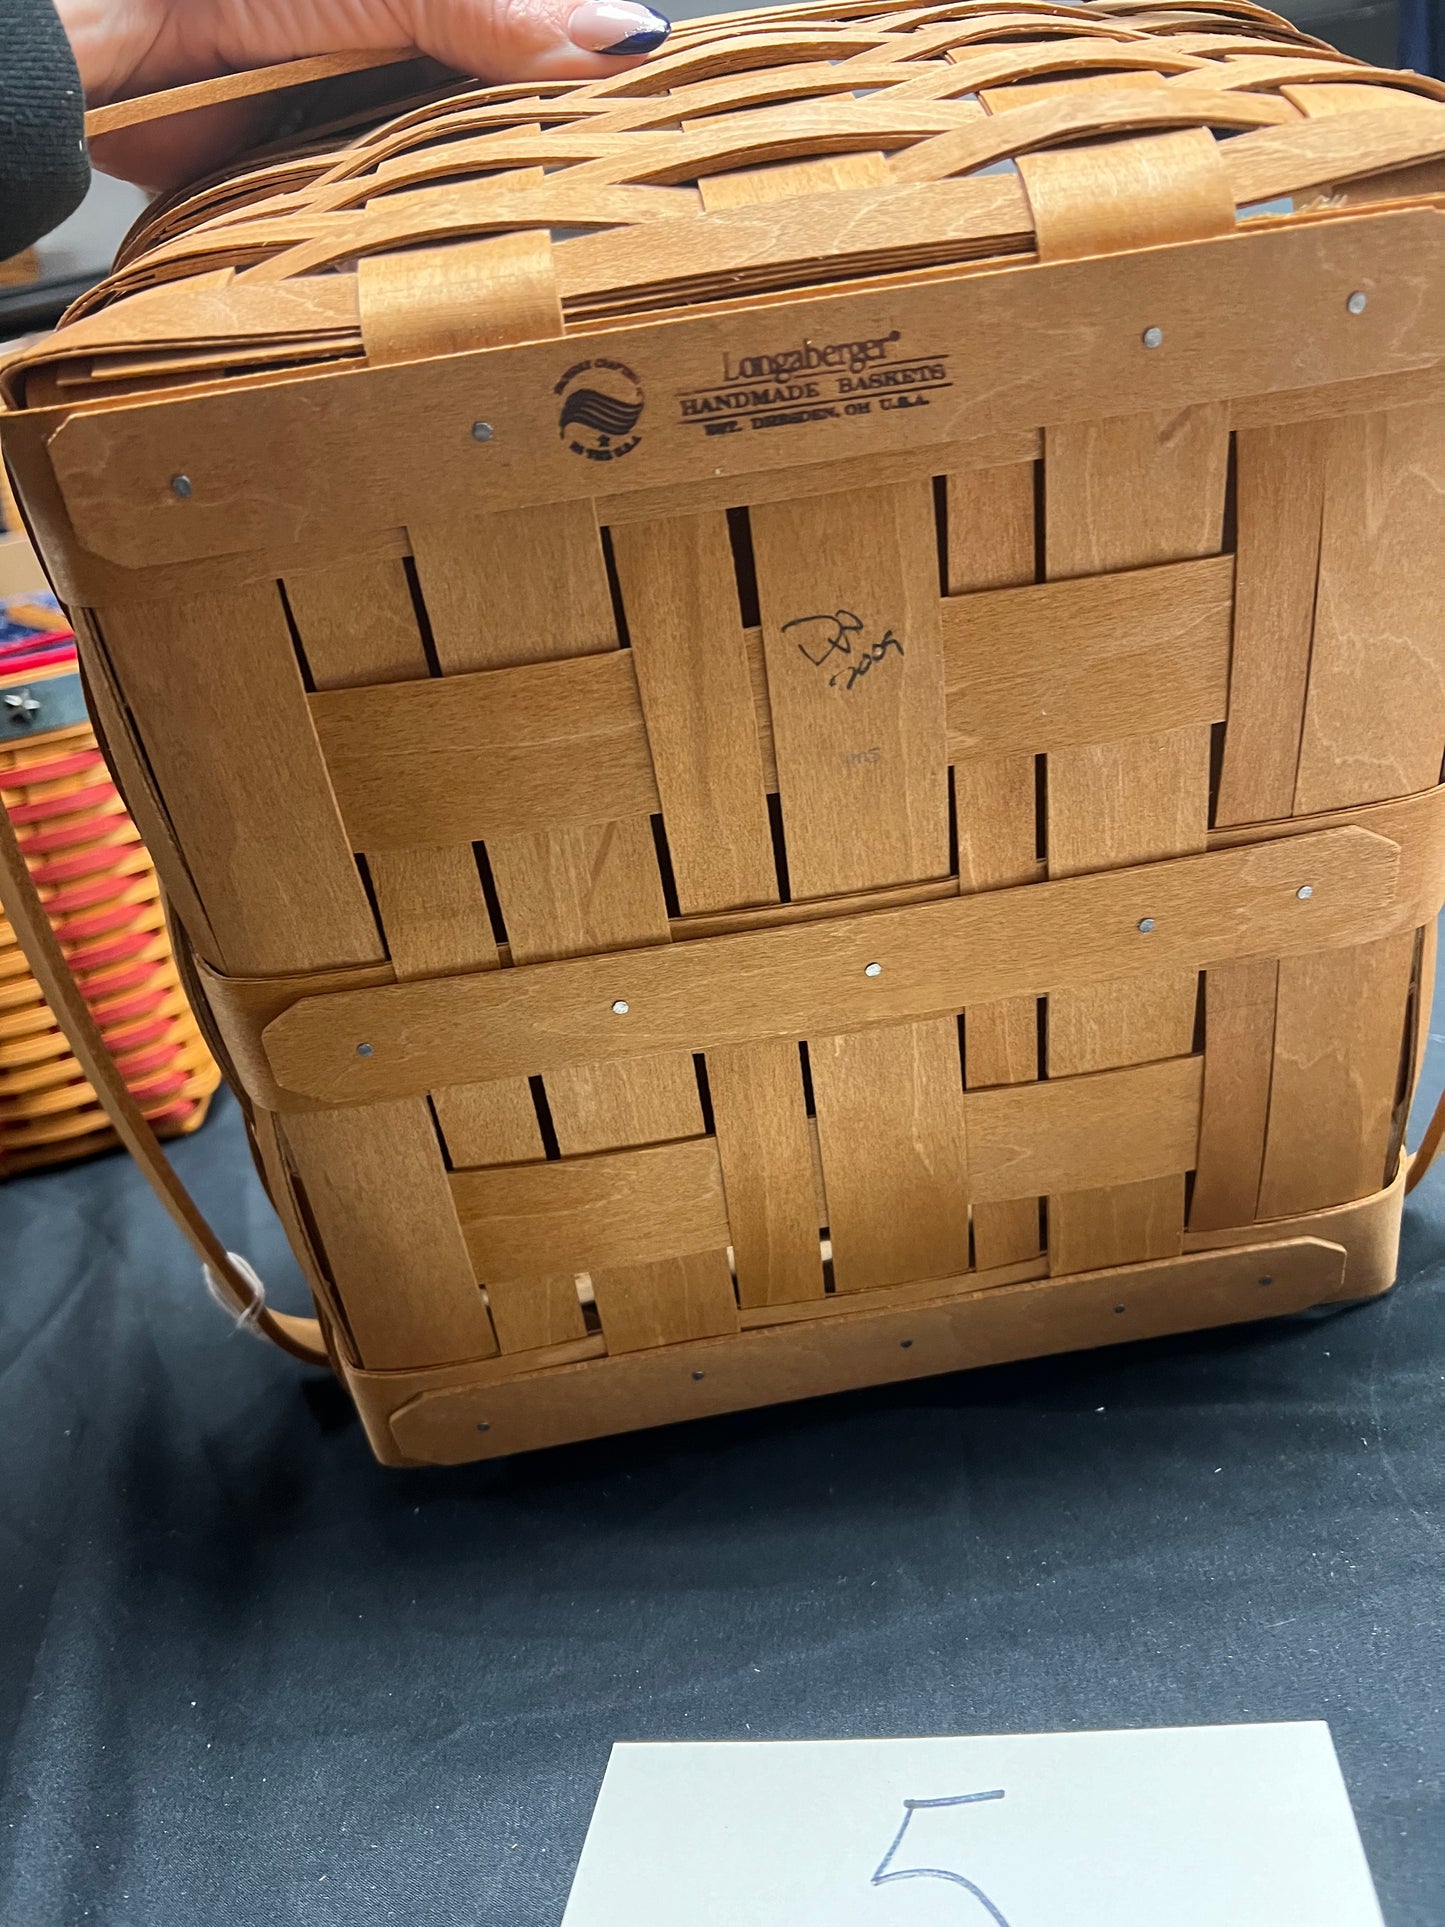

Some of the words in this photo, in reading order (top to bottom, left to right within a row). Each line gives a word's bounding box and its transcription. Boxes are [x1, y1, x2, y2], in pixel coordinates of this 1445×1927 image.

[680, 382, 821, 417] HANDMADE
[836, 364, 946, 394] BASKETS
[870, 1788, 1011, 1927] 5
